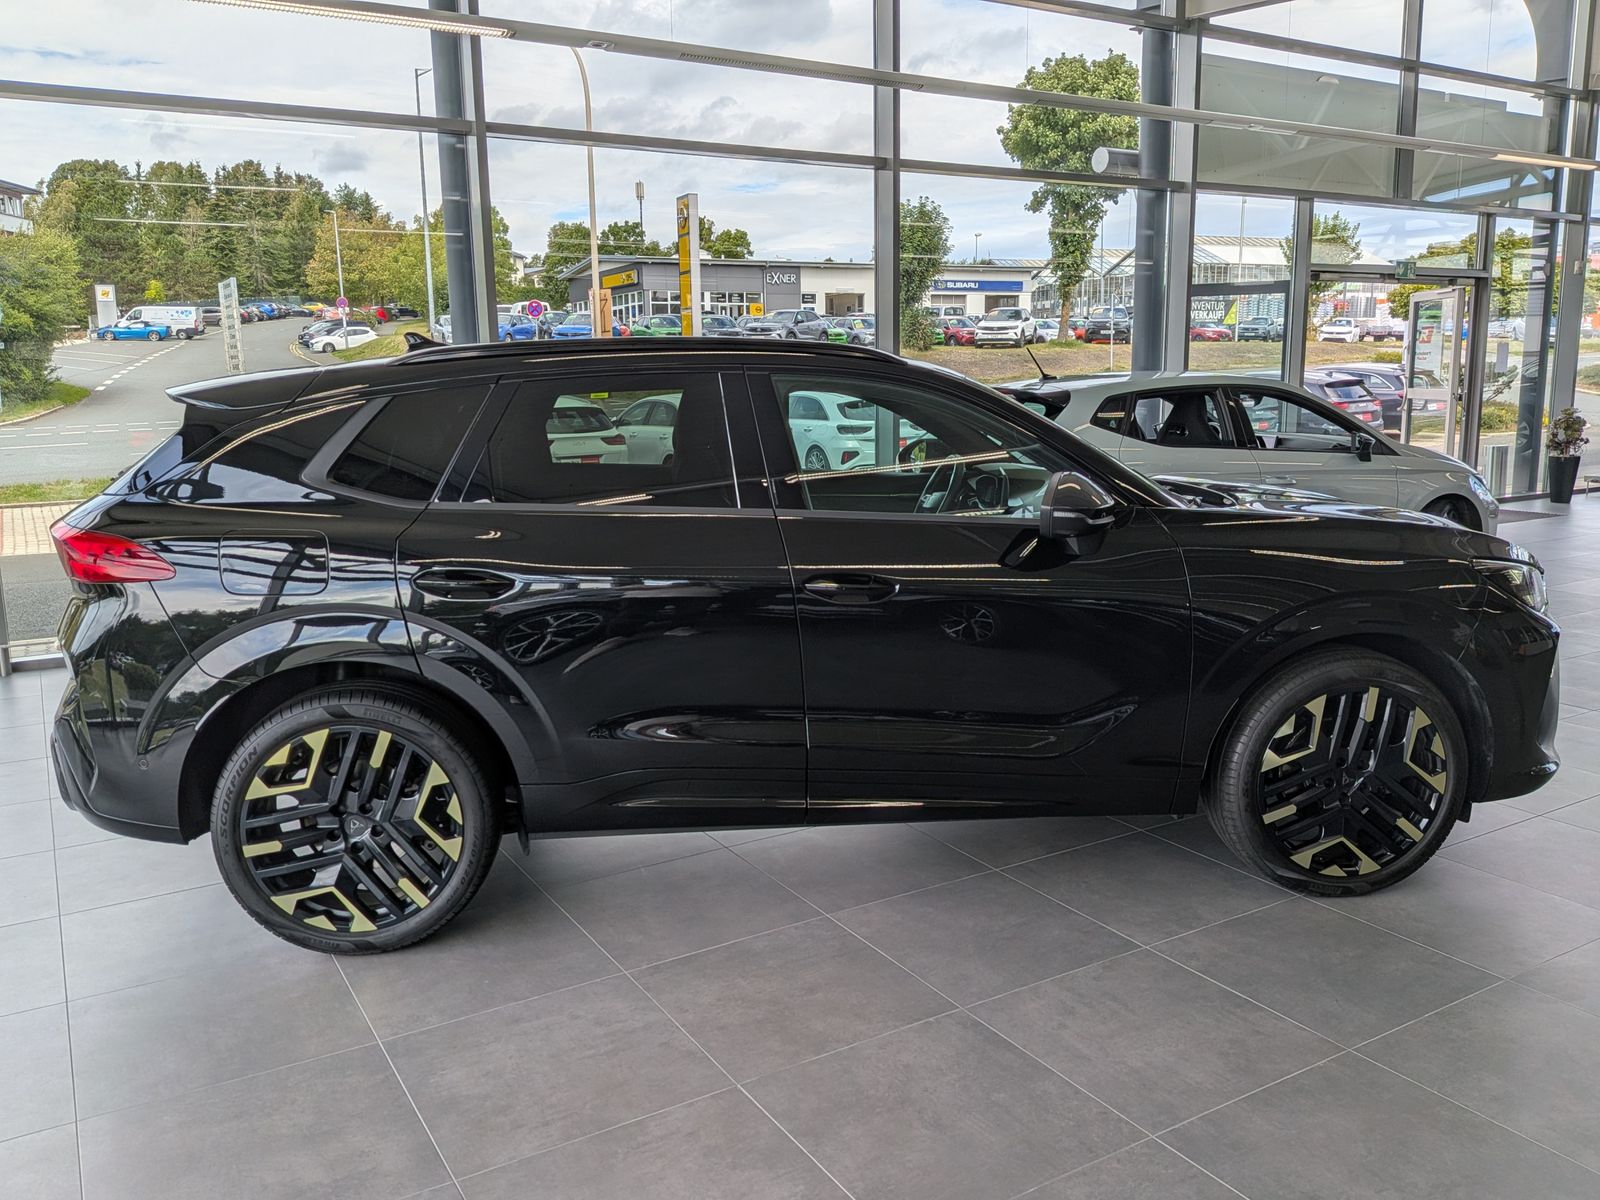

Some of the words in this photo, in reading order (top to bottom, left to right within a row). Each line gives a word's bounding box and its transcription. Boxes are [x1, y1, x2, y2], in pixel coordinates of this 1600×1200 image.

[767, 272, 796, 285] EXNER
[1191, 301, 1225, 310] NVENTUR
[220, 744, 260, 838] SCORPION
